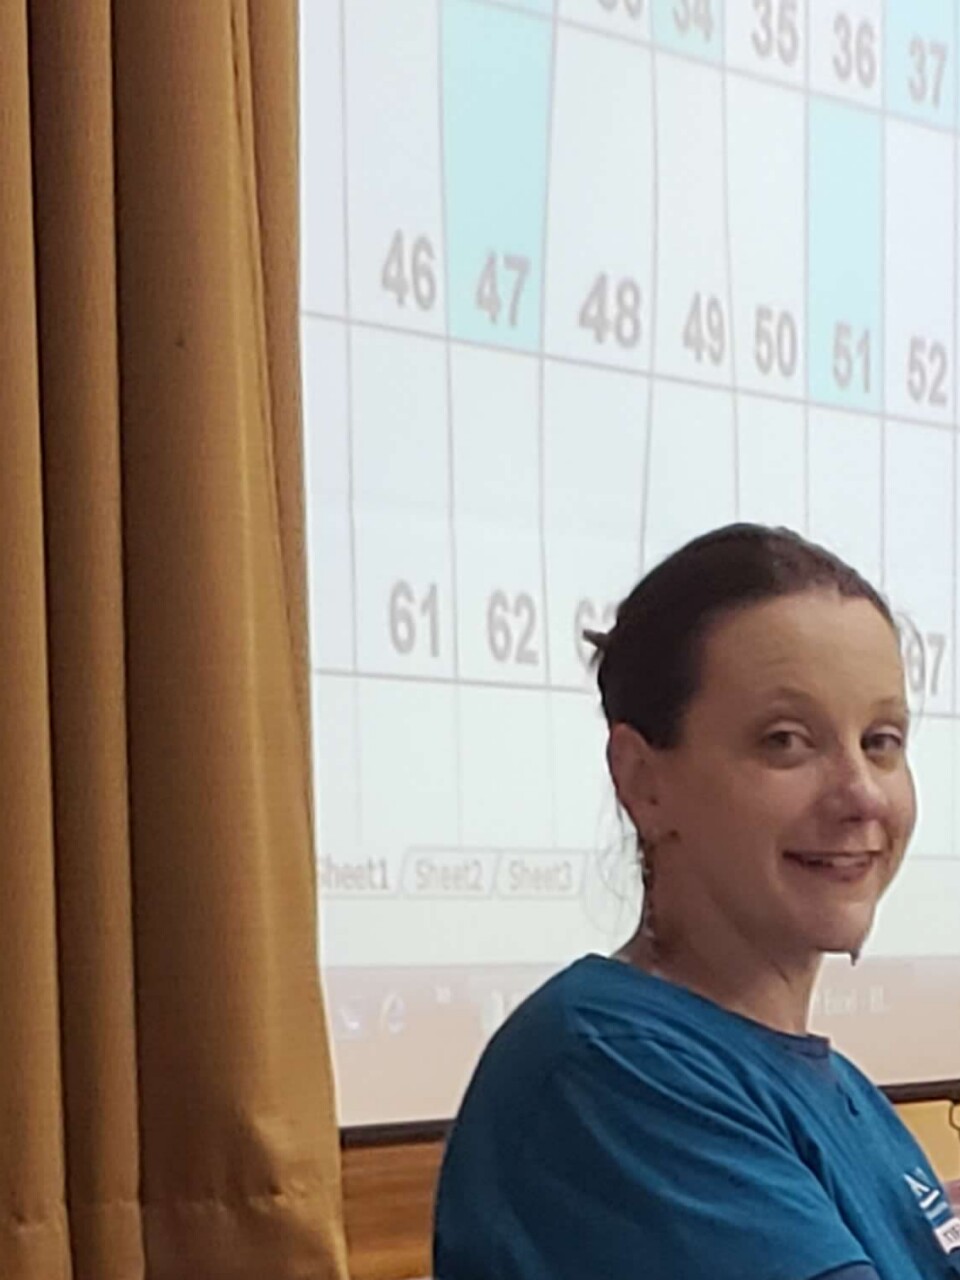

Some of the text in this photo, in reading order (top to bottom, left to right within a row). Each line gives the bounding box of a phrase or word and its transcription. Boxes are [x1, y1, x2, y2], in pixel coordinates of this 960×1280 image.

[751, 0, 799, 67] 35
[832, 12, 876, 89] 36
[908, 34, 948, 108] 37
[381, 229, 436, 312] 46
[475, 249, 531, 328] 47
[578, 272, 642, 349] 48
[682, 292, 724, 366] 49
[754, 305, 797, 377] 50
[832, 321, 872, 394] 51
[907, 335, 948, 409] 52
[389, 580, 440, 659] 61
[487, 589, 538, 666] 62
[575, 596, 618, 671] 6
